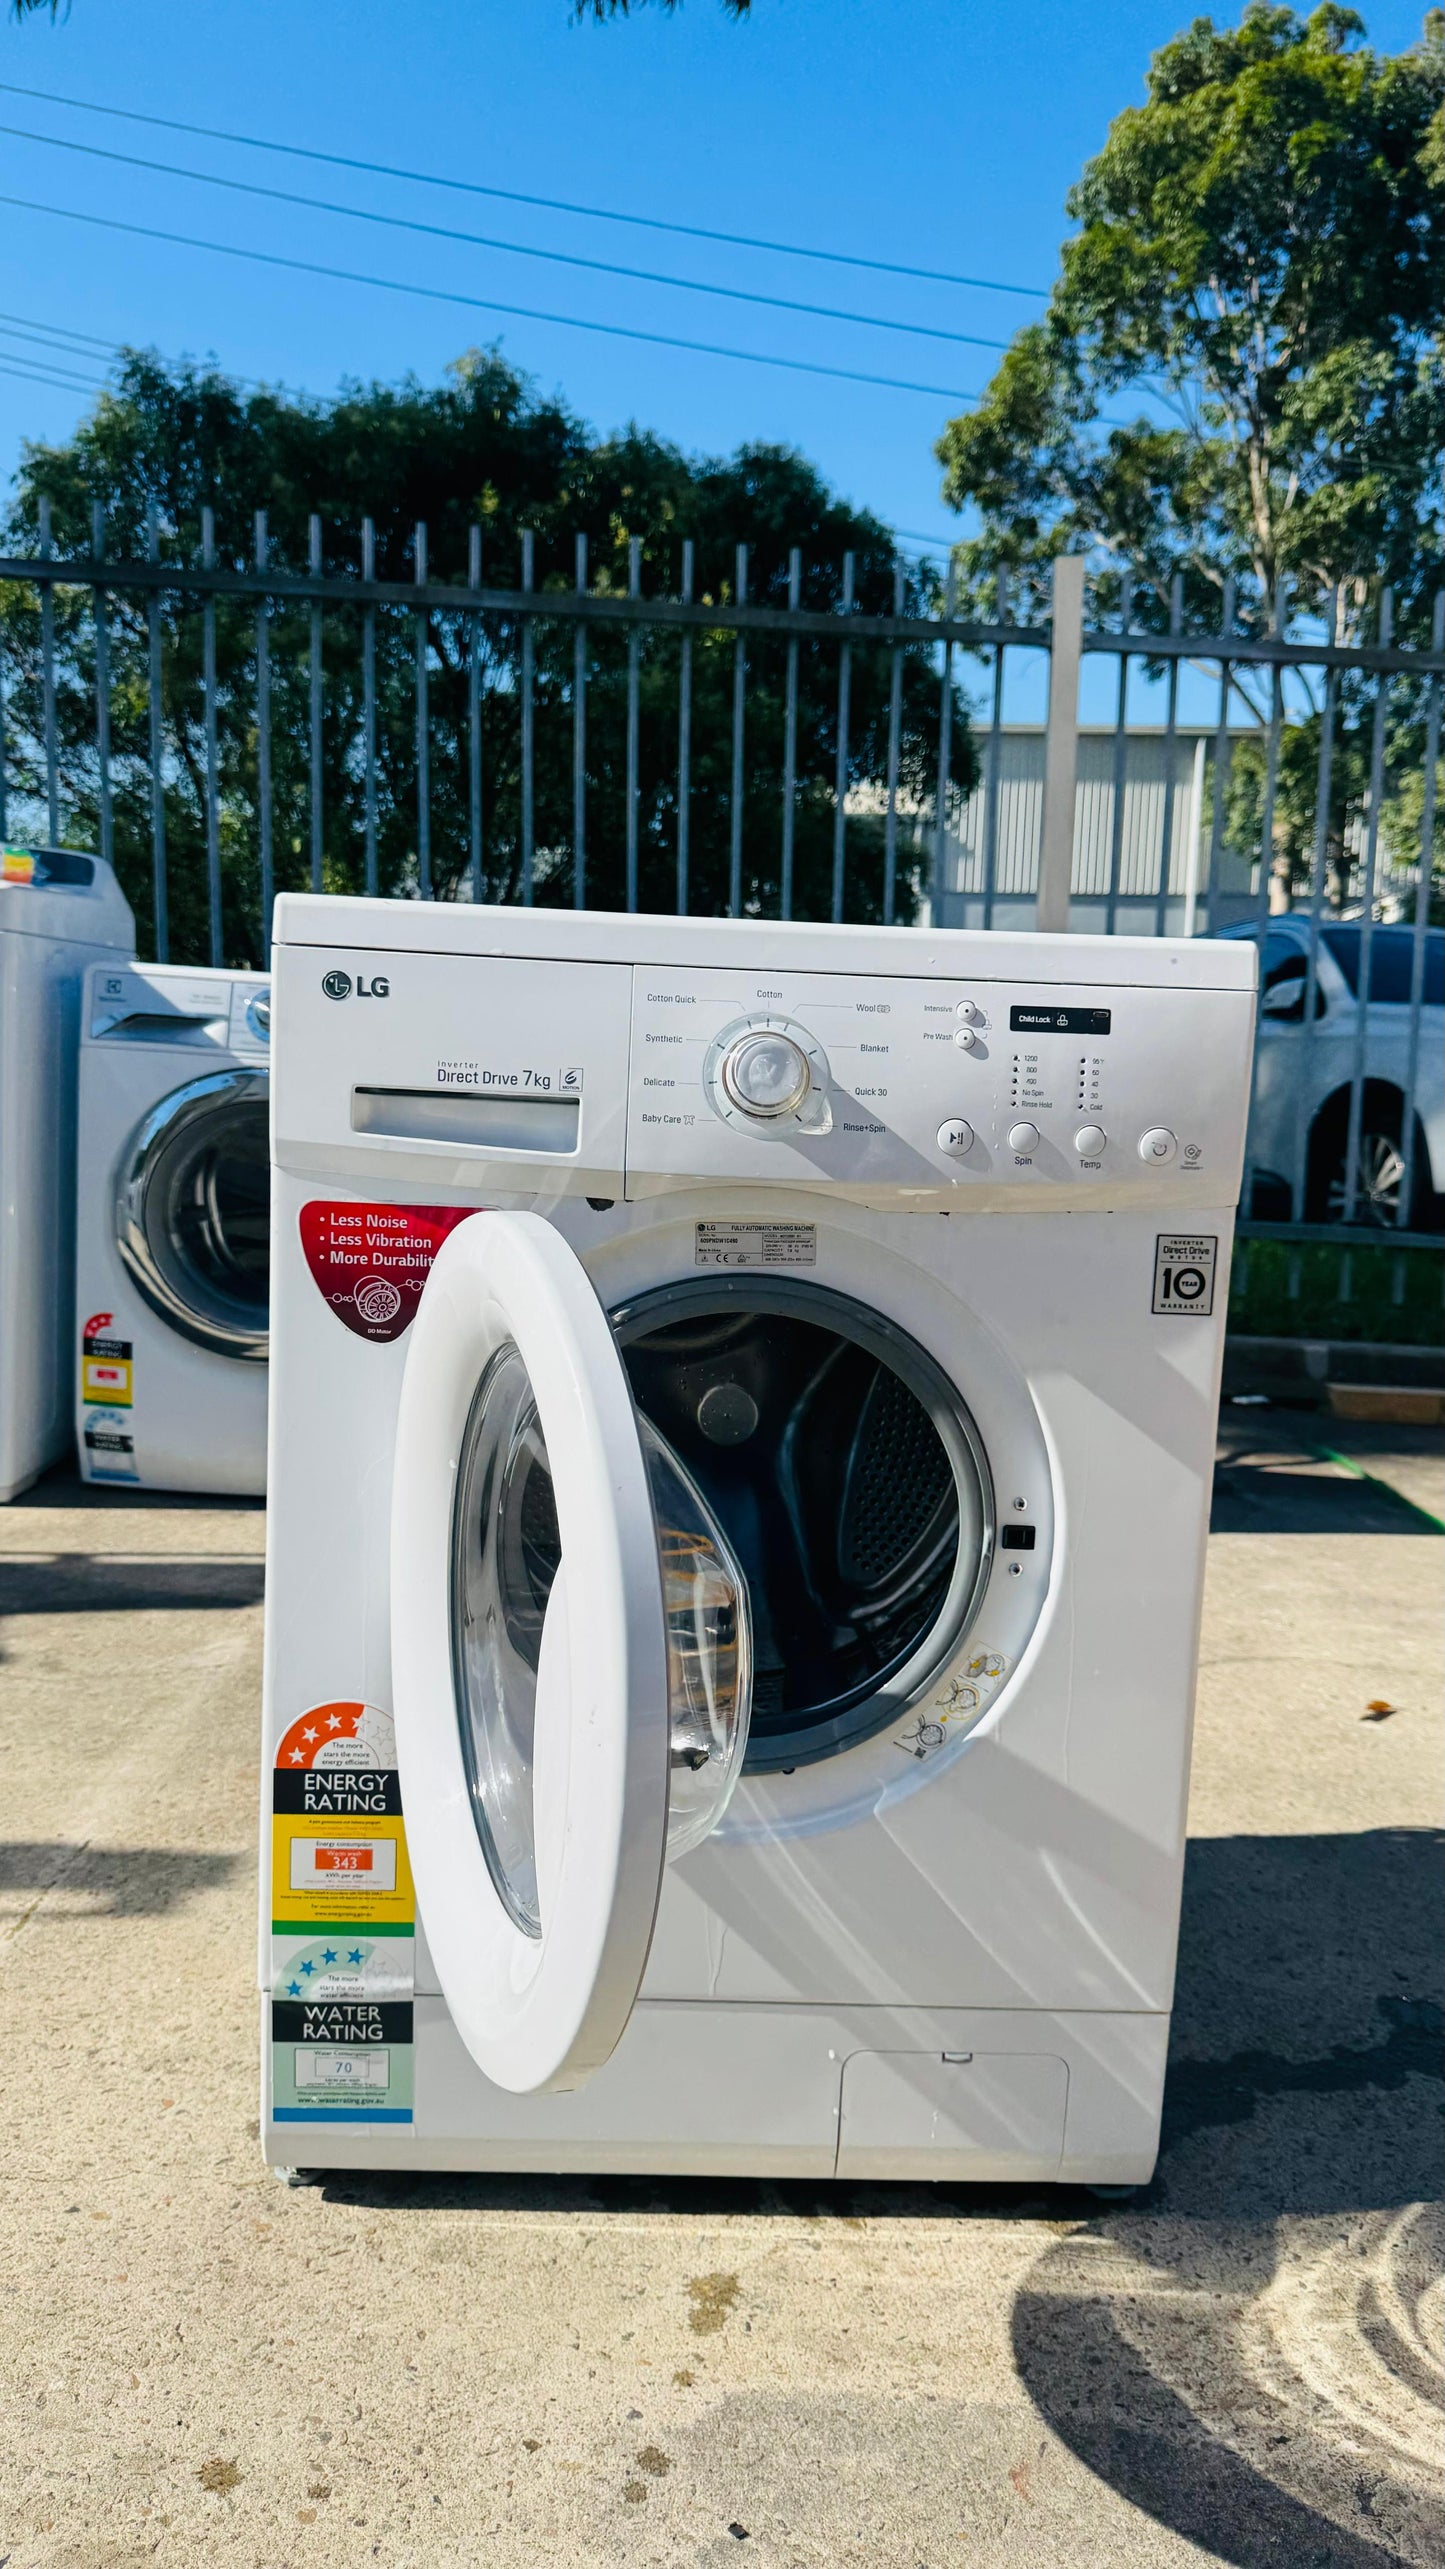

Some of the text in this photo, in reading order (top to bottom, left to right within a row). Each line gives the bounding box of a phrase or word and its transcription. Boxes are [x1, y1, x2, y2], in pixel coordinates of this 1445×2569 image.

[357, 976, 390, 998] LG
[647, 994, 697, 1004] Cotton Quick
[757, 990, 782, 999] Cotton
[856, 1003, 876, 1012] Wool
[924, 1005, 953, 1013] Intensive
[1019, 1015, 1035, 1023] Child
[645, 1034, 683, 1044] Synthetic
[935, 1033, 953, 1041] Wash
[860, 1044, 889, 1053] Blanket
[437, 1060, 479, 1069] Inverter
[437, 1069, 479, 1084] Direct
[482, 1071, 518, 1086] Drive
[643, 1078, 675, 1087] Delicate
[855, 1088, 888, 1097] Quick 30
[642, 1114, 681, 1124] Baby Care
[843, 1123, 886, 1134] Rinse+Spin
[1014, 1156, 1032, 1166] Spin
[1080, 1160, 1101, 1170] Temp
[330, 1213, 408, 1228] Less Noise
[330, 1232, 432, 1248] Less Vibration
[1163, 1246, 1210, 1255] Direct Drive
[330, 1251, 435, 1267] More Durabilit
[1163, 1268, 1206, 1300] 10
[304, 1774, 389, 1792] ENERGY
[304, 1794, 386, 1811] RATING
[333, 1857, 358, 1869] 343
[304, 2005, 381, 2022] WATER
[303, 2023, 383, 2040] RATING
[335, 2062, 352, 2073] 70
